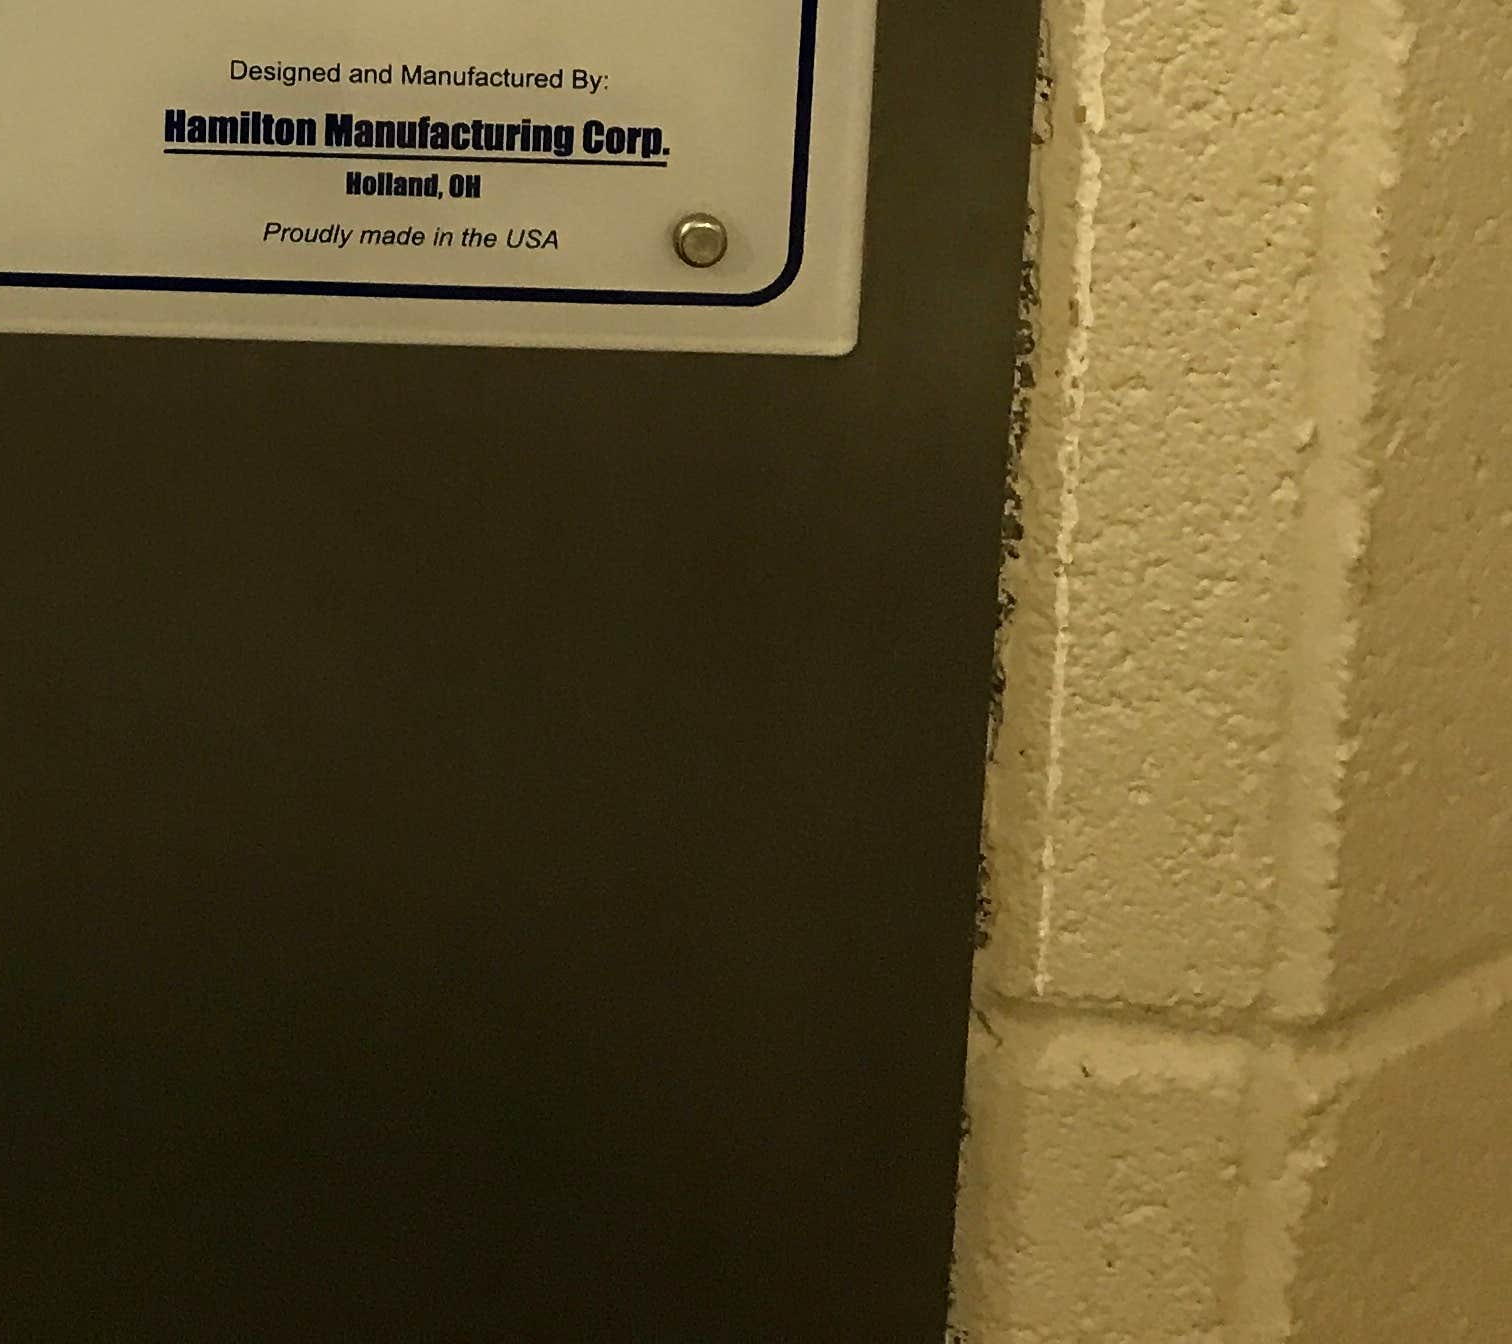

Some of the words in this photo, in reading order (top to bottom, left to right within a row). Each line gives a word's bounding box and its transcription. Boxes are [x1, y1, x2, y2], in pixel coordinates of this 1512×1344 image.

[230, 59, 341, 87] Designed
[348, 63, 393, 85] and
[401, 64, 564, 89] Manufactured
[572, 68, 610, 95] By:
[164, 108, 317, 147] Hamilton
[324, 112, 575, 156] Manufacturing
[582, 119, 671, 158] Corp.
[345, 171, 444, 200] Holland,
[448, 173, 481, 199] OH
[262, 221, 354, 249] Proudly
[359, 225, 426, 247] made
[432, 226, 454, 247] in
[461, 227, 498, 249] the
[506, 228, 559, 250] USA
